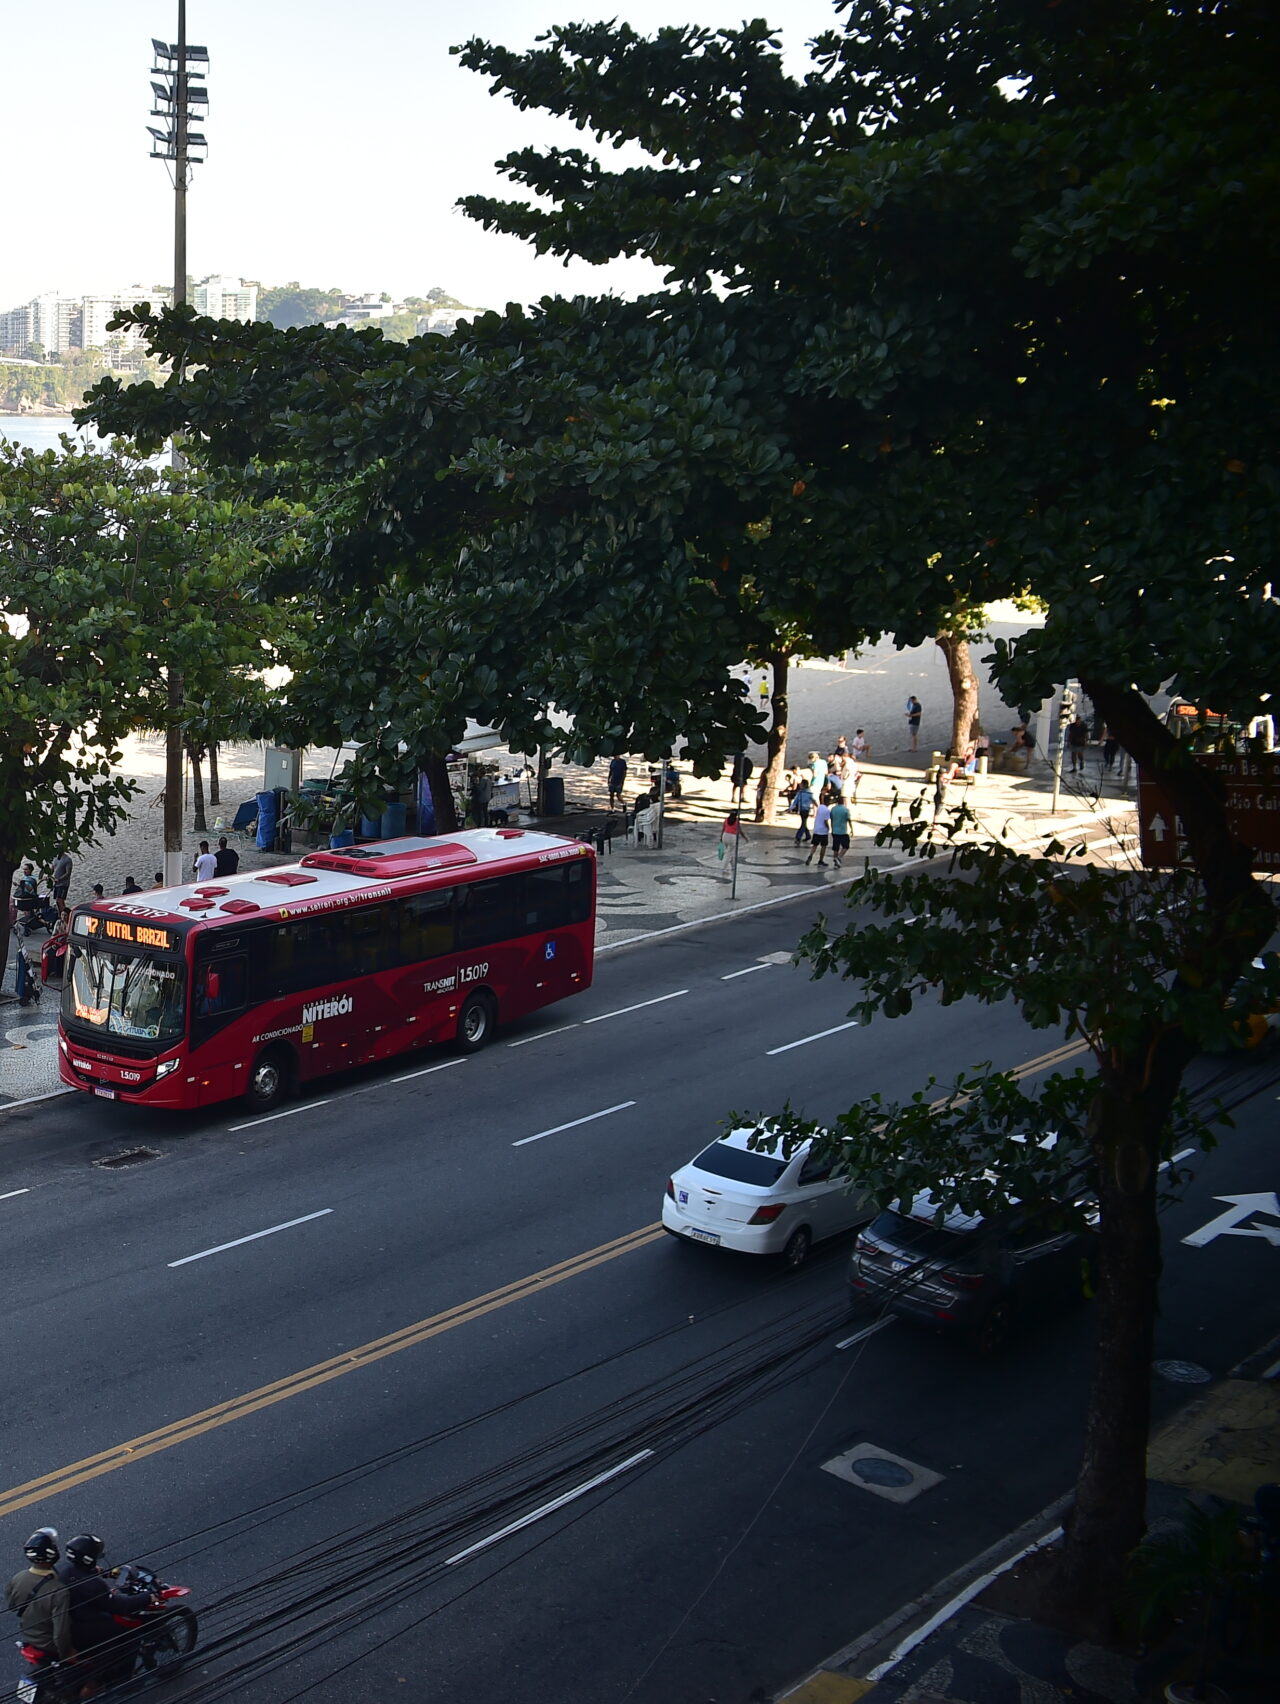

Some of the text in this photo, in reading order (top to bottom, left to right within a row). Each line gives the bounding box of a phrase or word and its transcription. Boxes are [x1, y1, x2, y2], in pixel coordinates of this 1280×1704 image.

[85, 916, 170, 948] 47 VITAL BRAZIL
[423, 962, 489, 992] TRANSNIT 1.5.019
[302, 994, 353, 1024] NITERÓI
[251, 1035, 260, 1043] AR
[260, 1024, 304, 1041] CONDICIONADO
